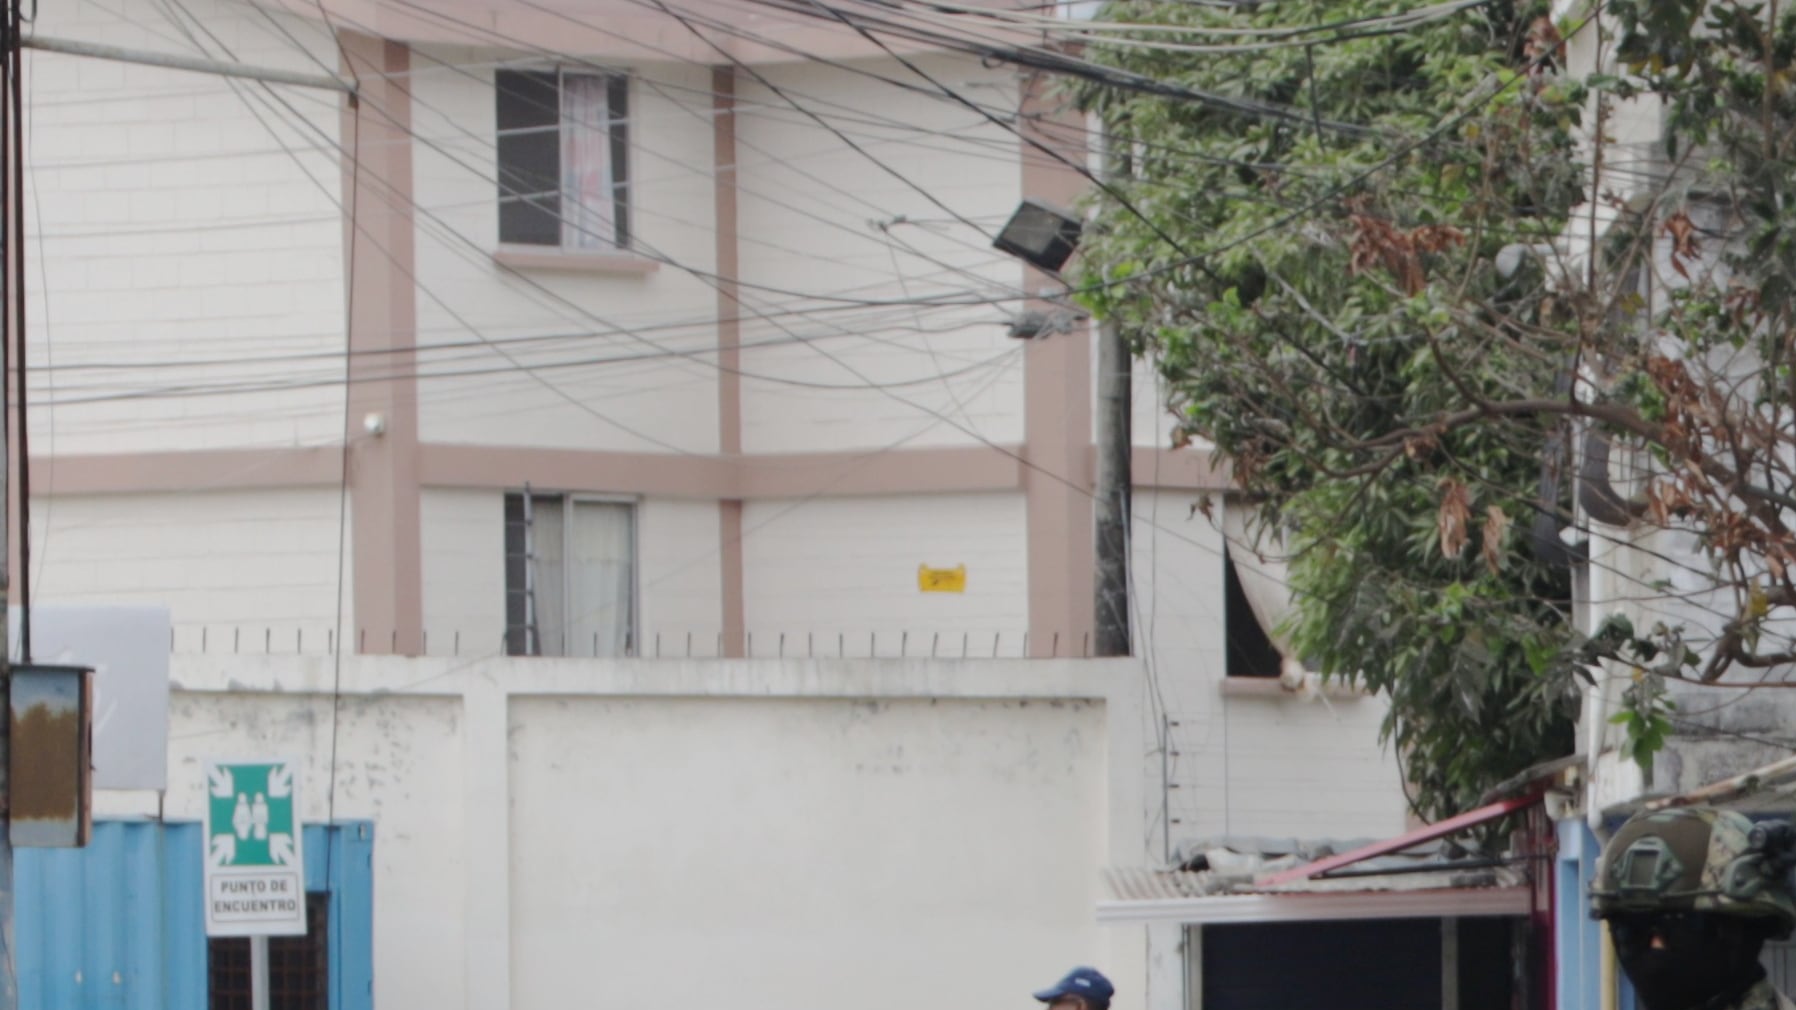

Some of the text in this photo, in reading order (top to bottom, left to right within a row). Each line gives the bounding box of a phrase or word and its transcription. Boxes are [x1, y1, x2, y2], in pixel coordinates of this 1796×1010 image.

[220, 879, 288, 894] PUNTO DE
[213, 899, 297, 913] ENCUENTRO
